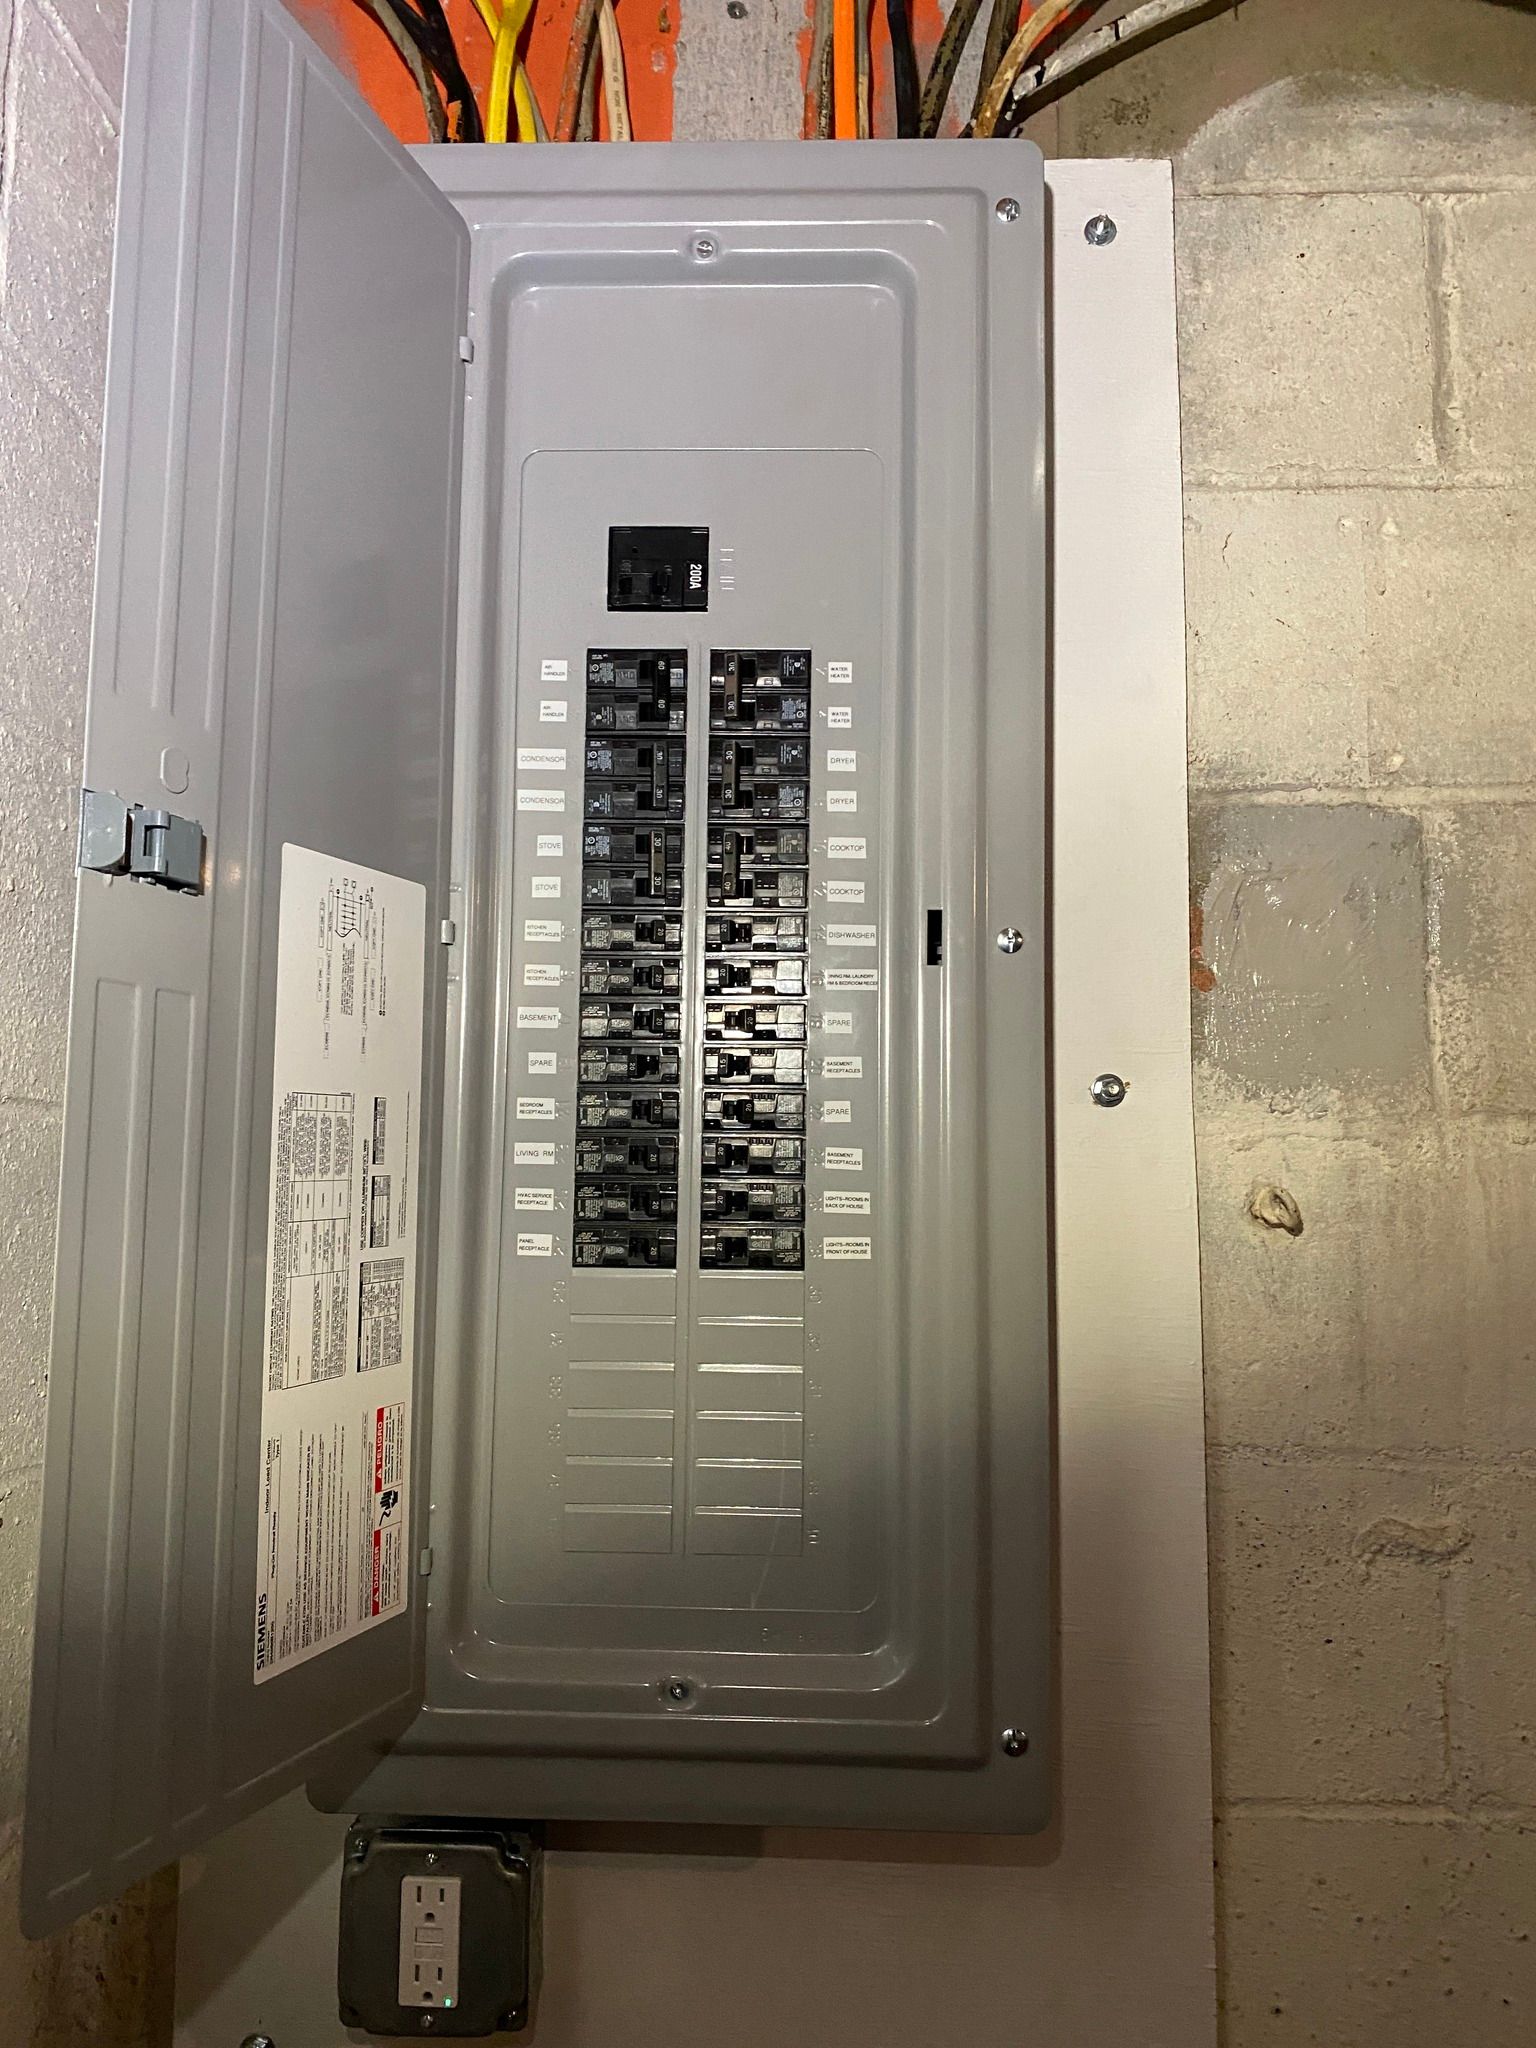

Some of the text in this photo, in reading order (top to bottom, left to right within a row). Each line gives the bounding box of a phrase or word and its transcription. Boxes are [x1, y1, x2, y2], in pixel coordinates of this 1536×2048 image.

[690, 564, 702, 589] 200A
[658, 660, 665, 670] 60
[728, 662, 736, 671] 30
[728, 701, 735, 710] 30
[656, 751, 663, 760] 30
[726, 750, 733, 760] 30
[656, 789, 663, 799] 30
[725, 789, 732, 799] 30
[654, 837, 661, 846] 30
[725, 841, 731, 850] 40
[654, 876, 661, 886] 30
[724, 881, 731, 890] 40
[657, 928, 664, 936] 20
[721, 923, 728, 932] 20
[720, 968, 726, 976] 20
[656, 1018, 662, 1026] 20
[747, 1016, 753, 1025] 20
[650, 1154, 657, 1162] 20
[717, 1196, 724, 1204] 20
[652, 1201, 659, 1210] 20
[650, 1247, 657, 1256] 20
[716, 1243, 723, 1251] 20
[257, 1593, 267, 1671] SIEMENS
